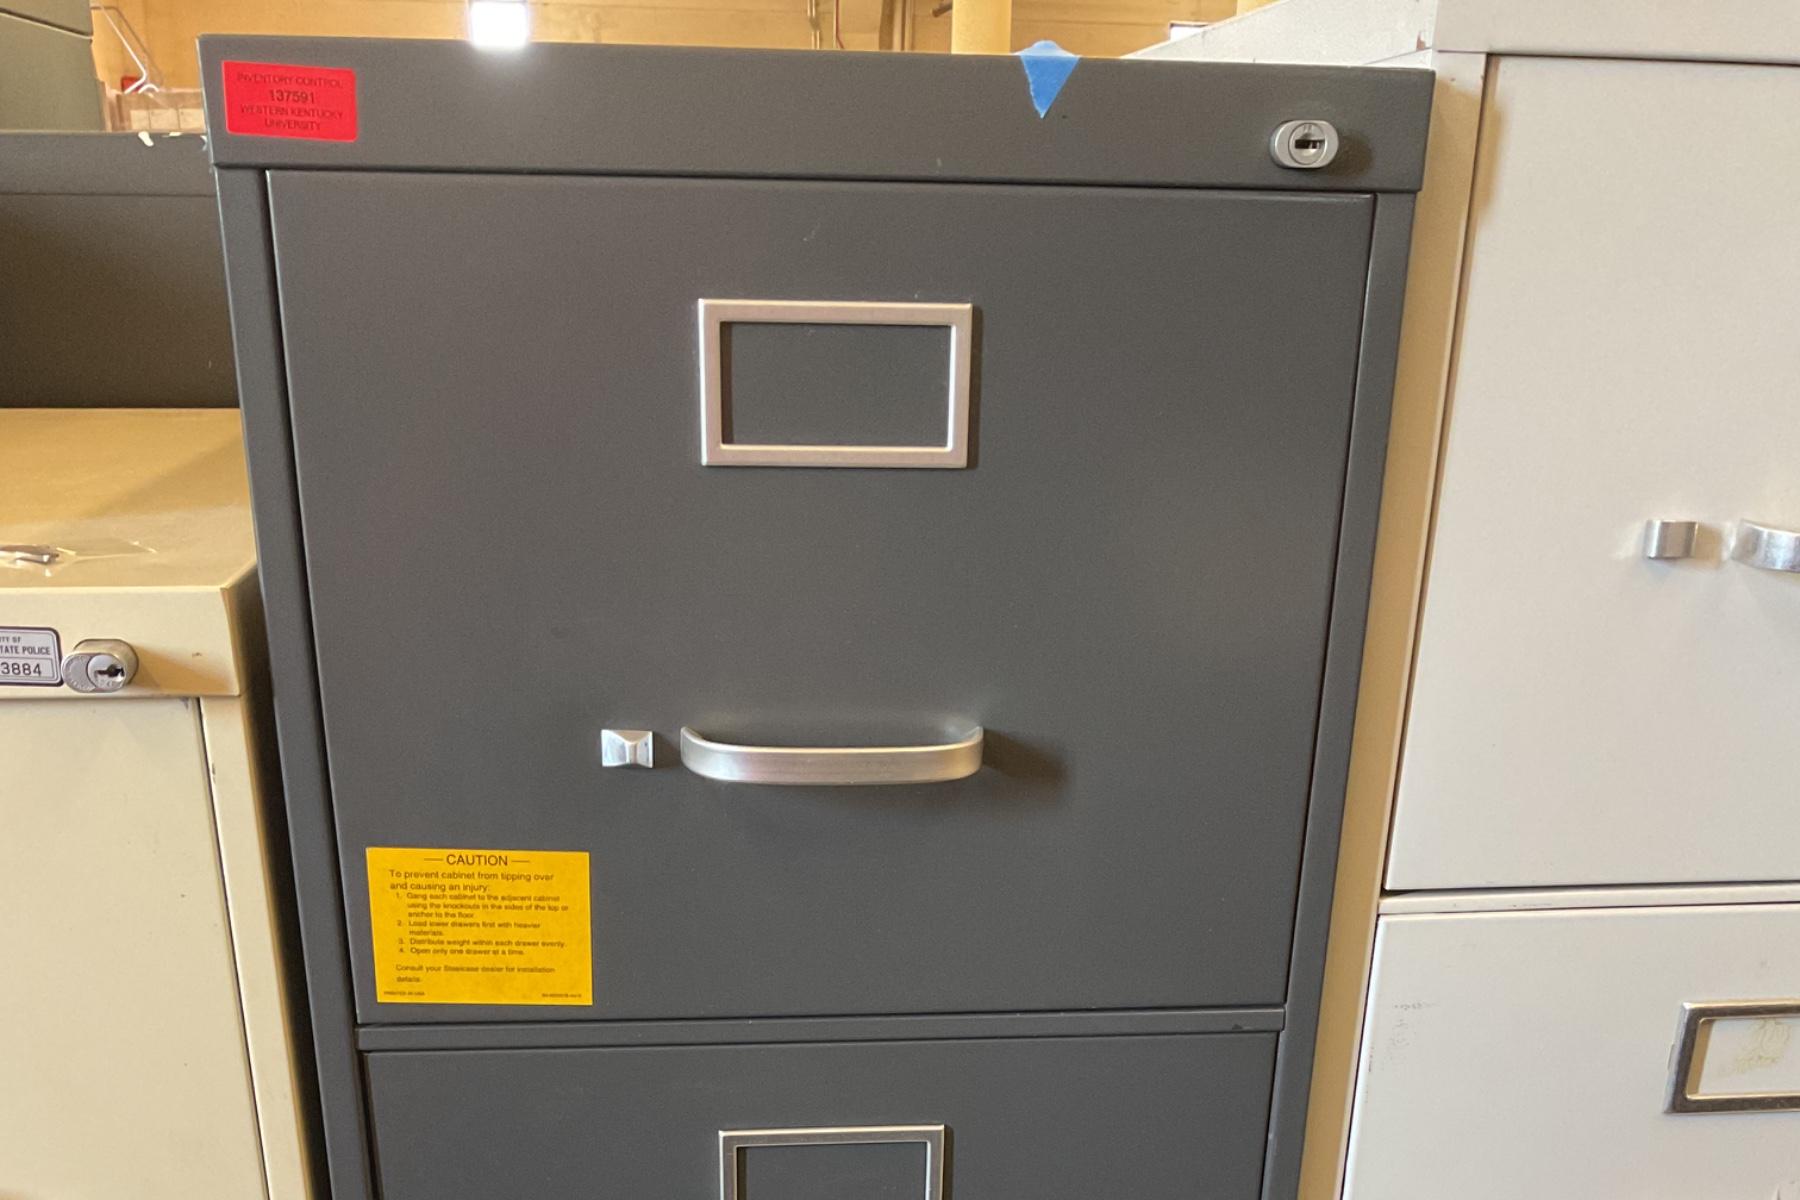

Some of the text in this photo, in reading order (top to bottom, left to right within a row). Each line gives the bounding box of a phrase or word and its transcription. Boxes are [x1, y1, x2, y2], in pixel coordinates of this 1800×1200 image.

[237, 72, 343, 87] INVENTORY CONTROL
[270, 90, 315, 103] 137591
[241, 104, 343, 119] WESTERN KENTUCKY
[264, 119, 320, 130] UNIVERSITY
[22, 646, 50, 655] POLICE
[1, 662, 41, 676] 3884
[446, 854, 508, 866] CAUTION
[389, 869, 401, 878] To
[404, 871, 439, 880] prevent
[441, 871, 475, 879] cabinet
[501, 873, 531, 882] tipping
[410, 883, 446, 892] causing
